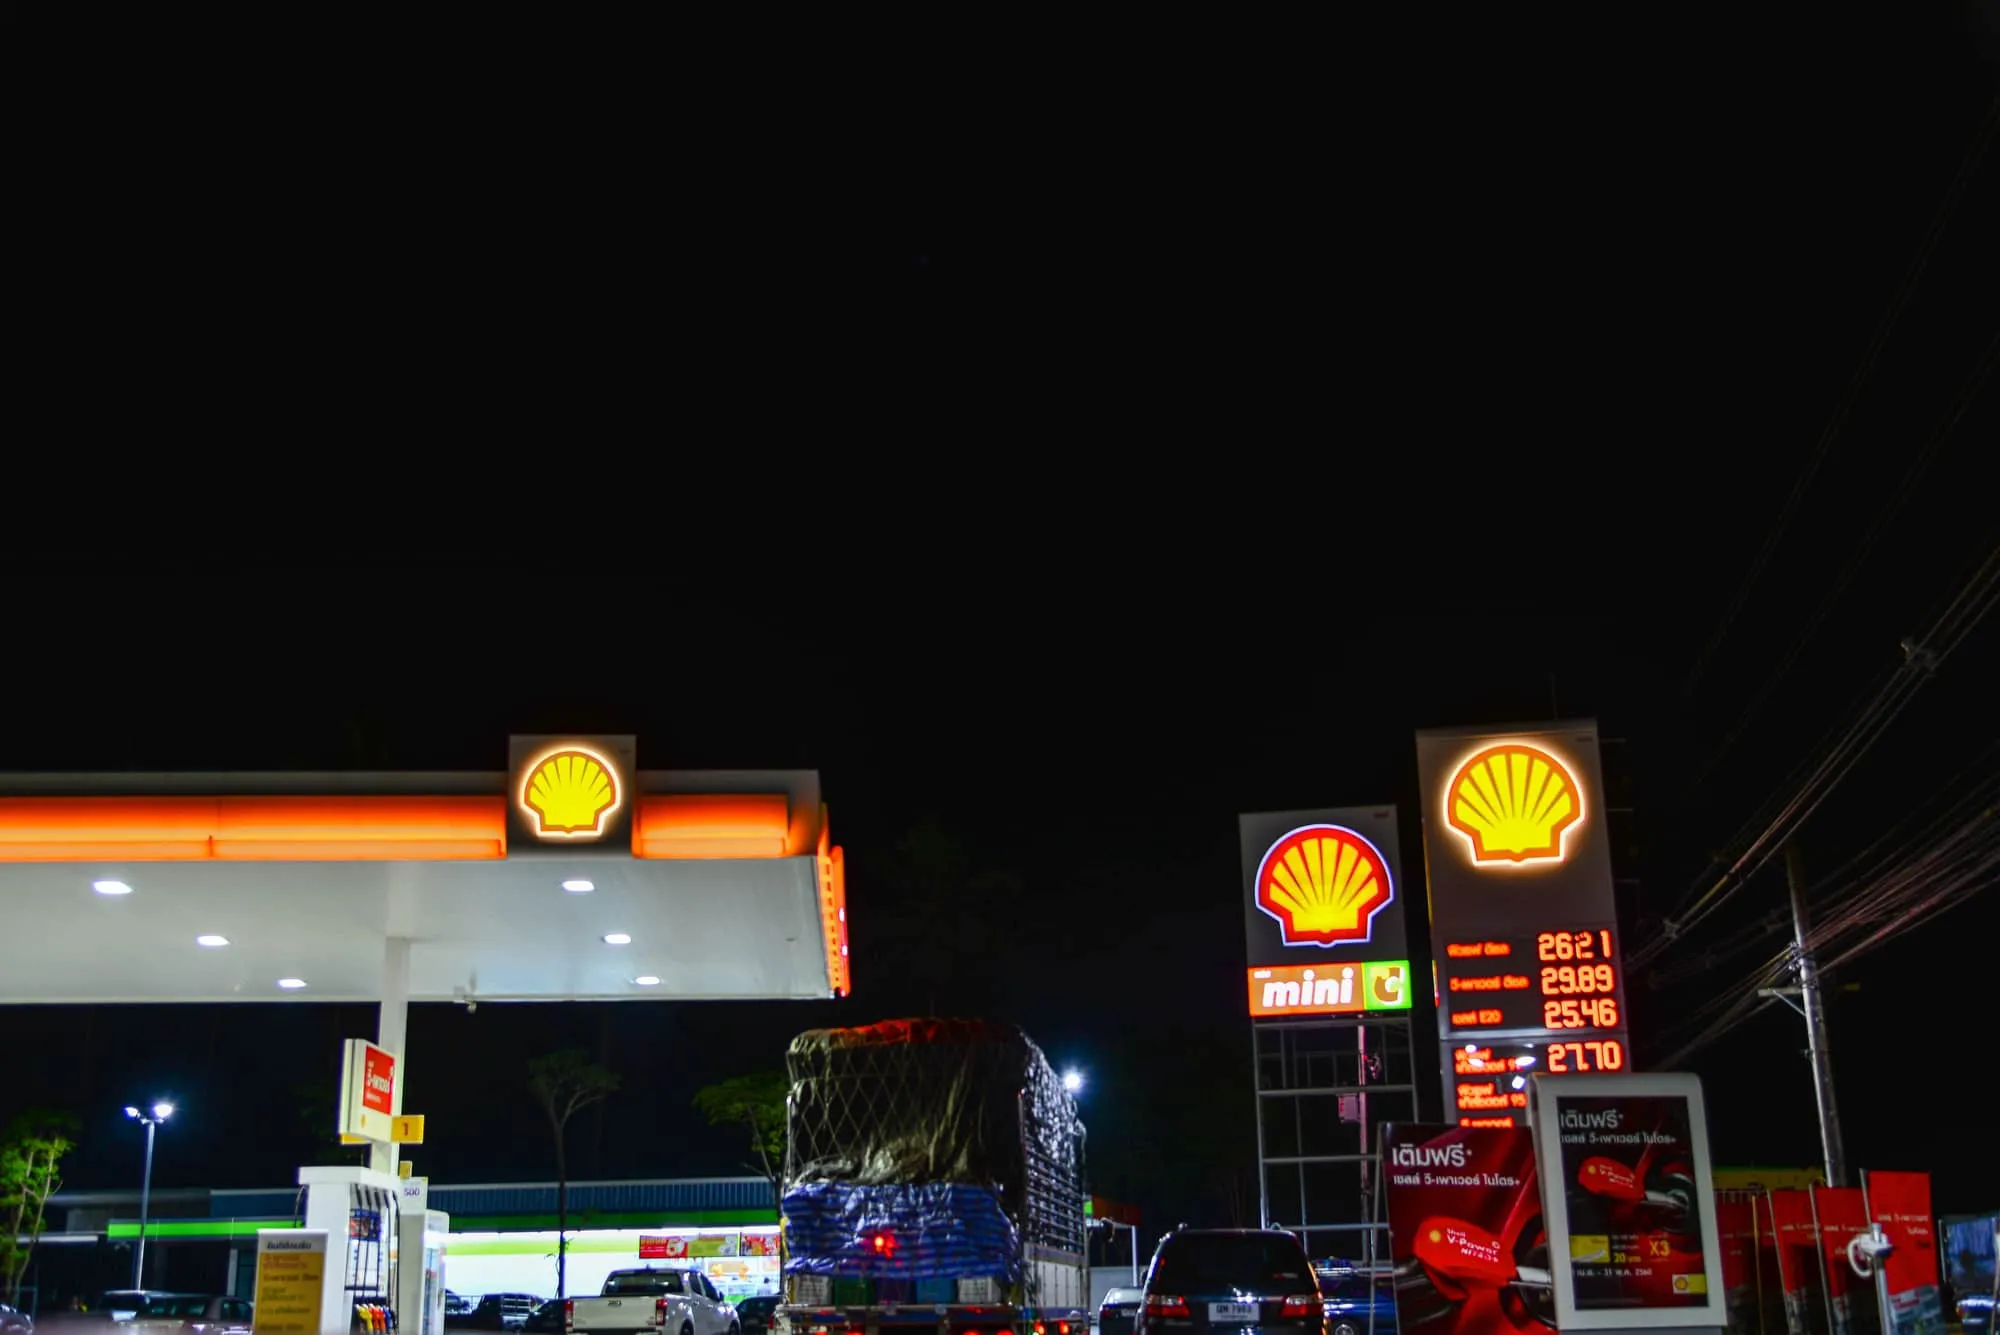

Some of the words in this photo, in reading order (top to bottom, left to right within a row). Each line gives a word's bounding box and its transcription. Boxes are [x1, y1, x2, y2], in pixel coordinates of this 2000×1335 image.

[1262, 967, 1354, 1007] mini
[1541, 964, 1614, 995] 29.89
[1544, 998, 1617, 1029] 25.46
